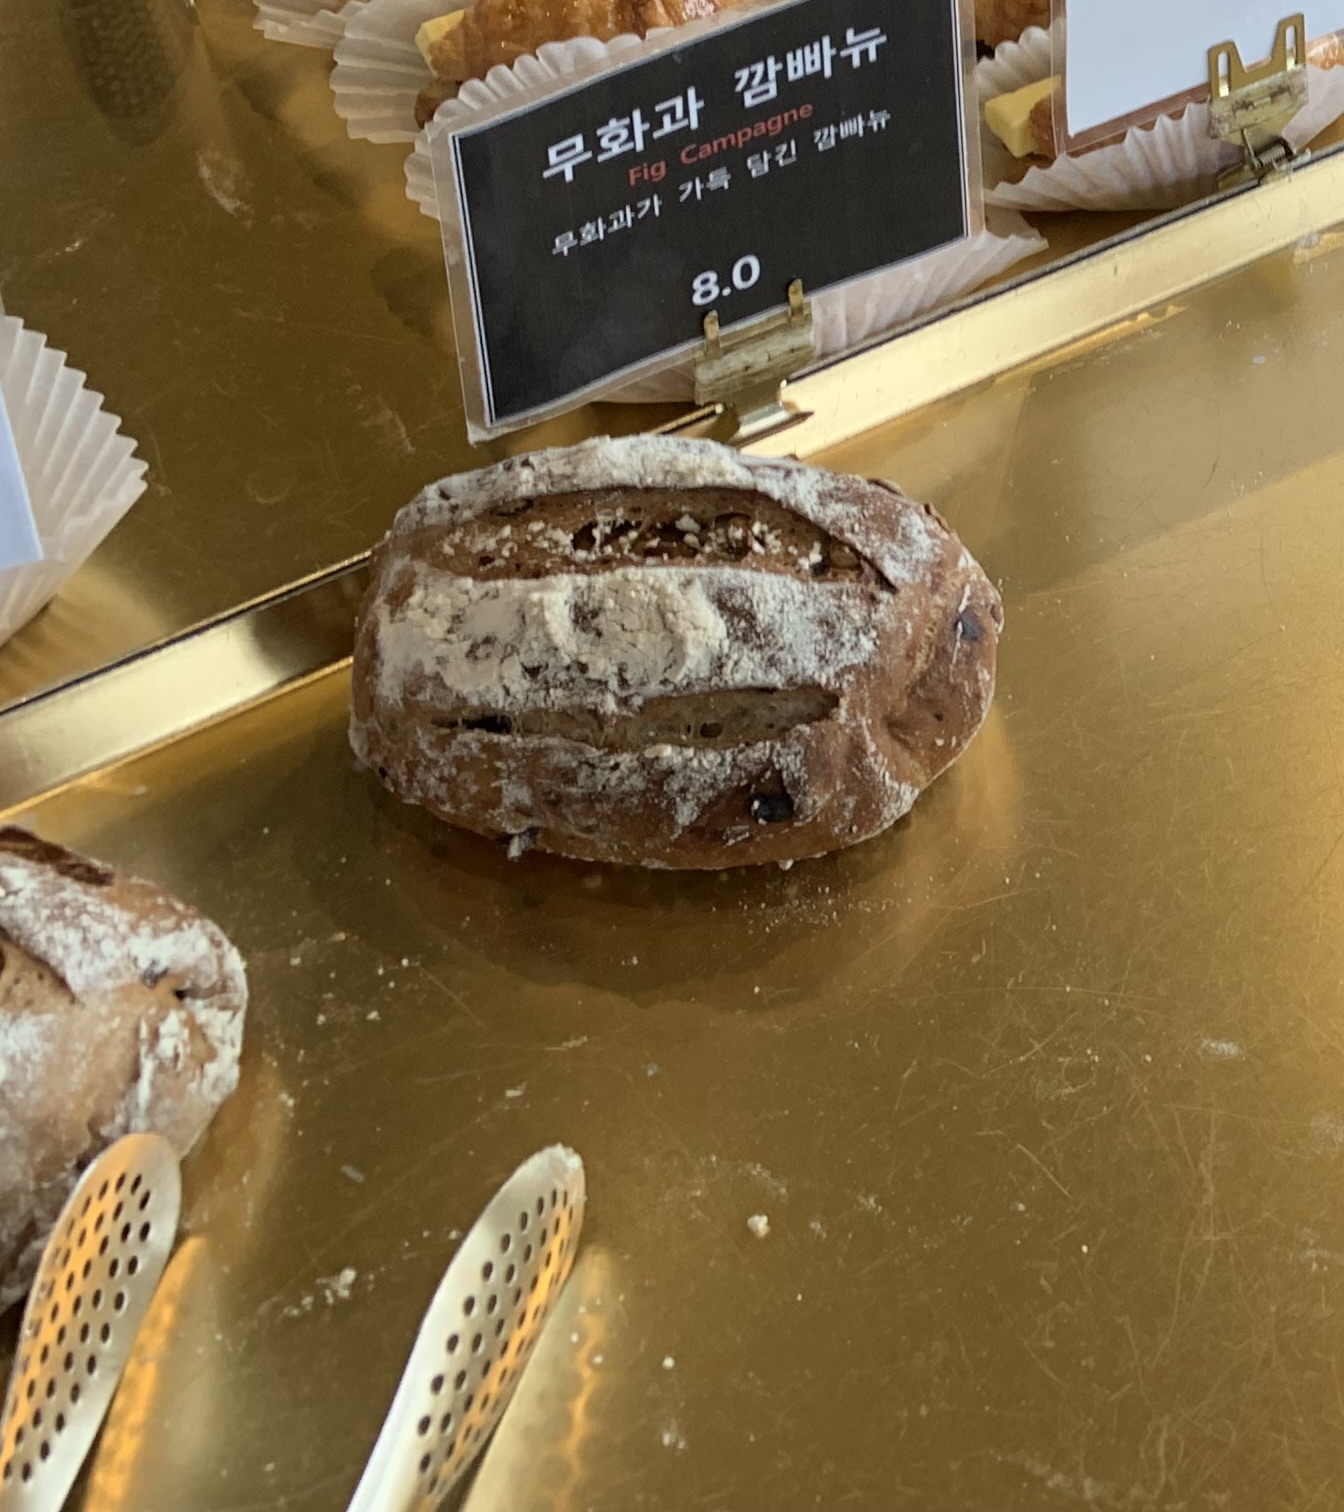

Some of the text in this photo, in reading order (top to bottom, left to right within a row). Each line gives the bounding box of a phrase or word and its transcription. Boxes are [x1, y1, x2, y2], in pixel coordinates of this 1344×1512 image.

[542, 26, 888, 183] 무화과 깜빠뉴
[628, 102, 815, 187] Fig Campagne
[552, 108, 892, 257] 무화과가 가득 담긴 깜빠뉴
[692, 254, 762, 306] 8.0
